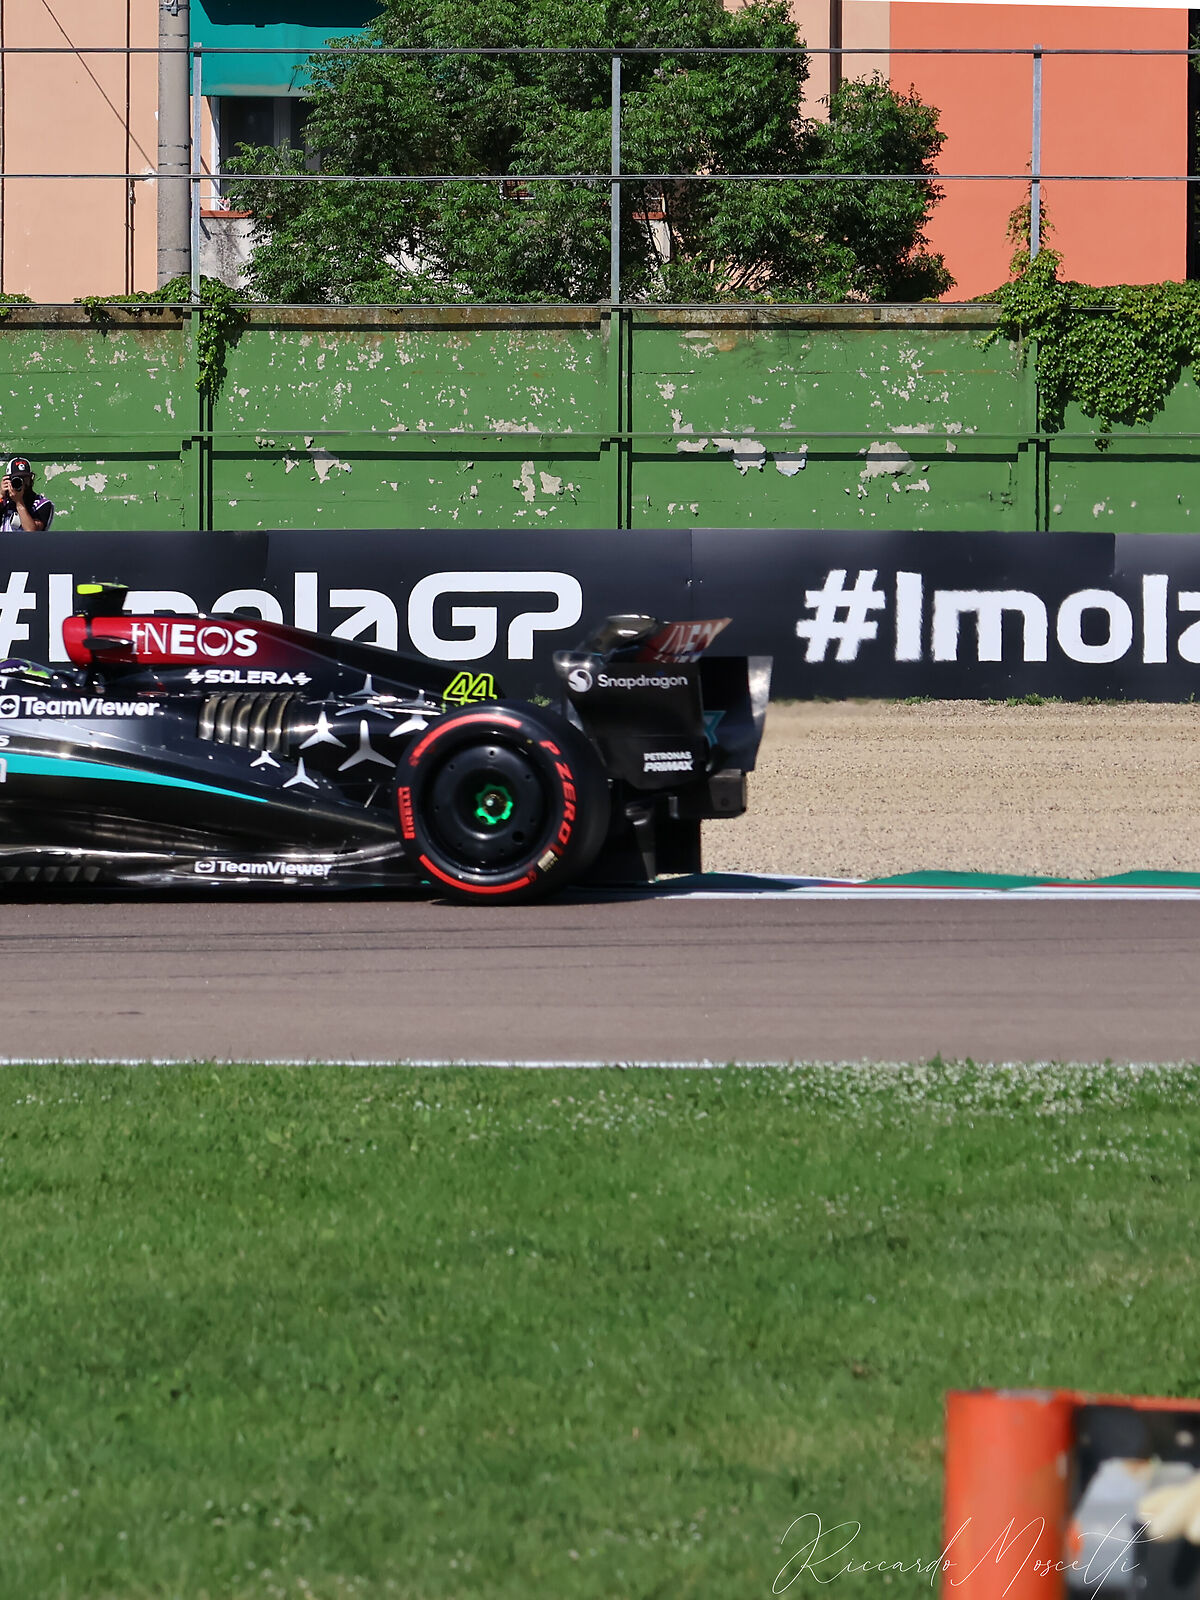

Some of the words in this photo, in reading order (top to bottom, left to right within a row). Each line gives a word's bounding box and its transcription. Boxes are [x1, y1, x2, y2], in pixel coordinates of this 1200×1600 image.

[130, 622, 258, 657] INEOS
[203, 669, 295, 685] SOLERA
[597, 673, 689, 690] Snapdragon
[442, 671, 497, 706] 44
[21, 697, 160, 717] TeamViewer
[643, 751, 692, 761] PETRONAS
[643, 760, 694, 772] PRIMAX
[554, 761, 577, 845] ZERO
[216, 860, 332, 876] TeamViewer
